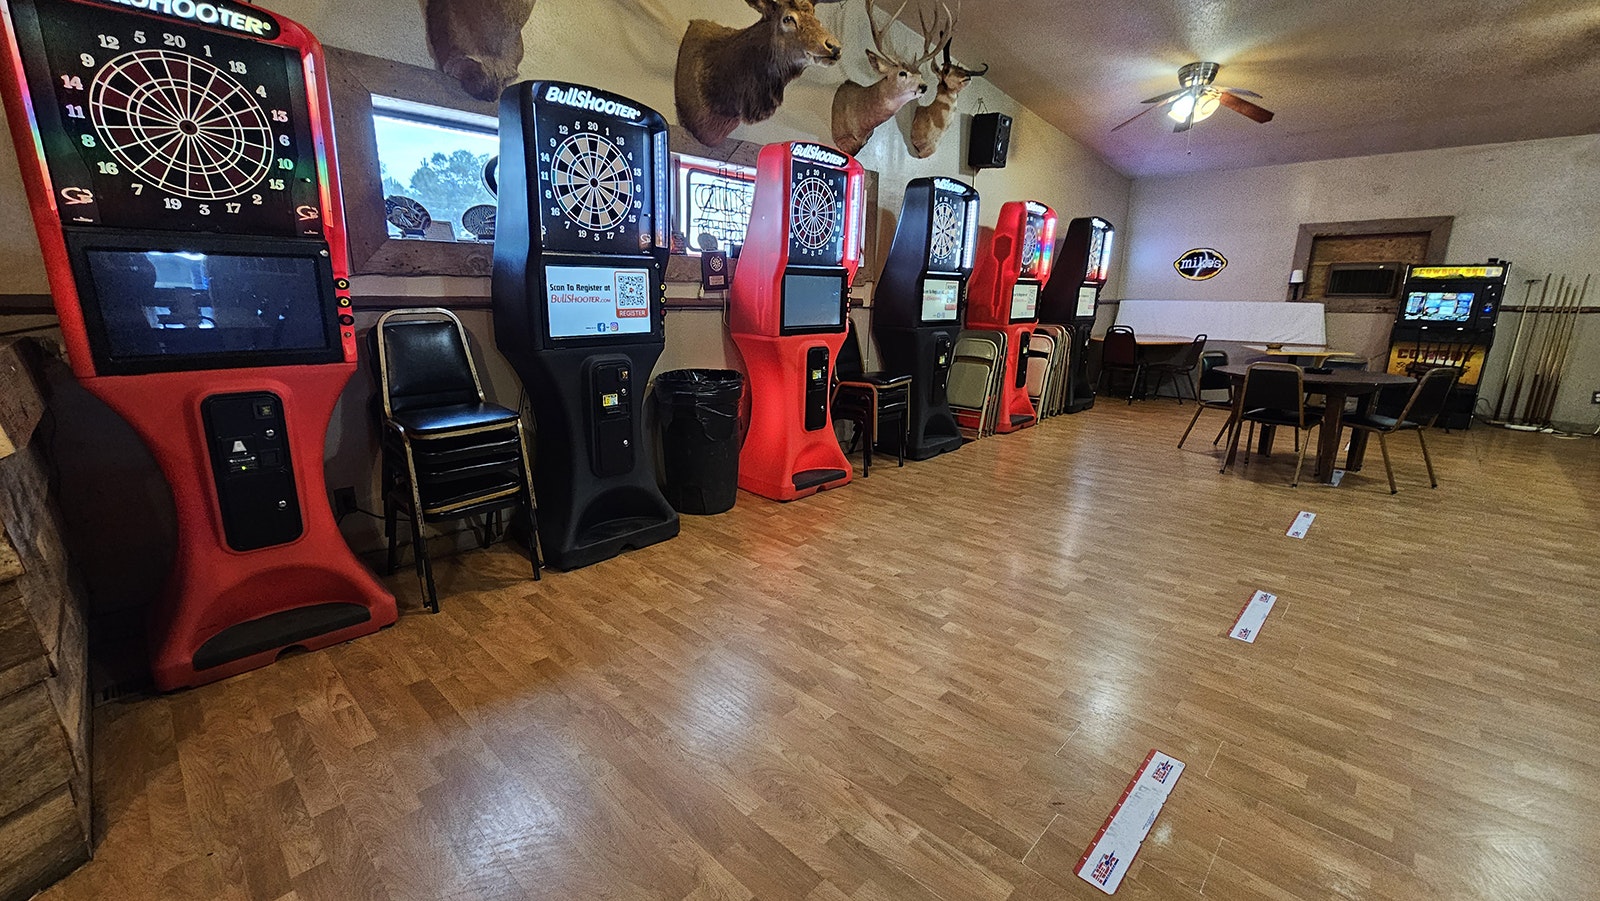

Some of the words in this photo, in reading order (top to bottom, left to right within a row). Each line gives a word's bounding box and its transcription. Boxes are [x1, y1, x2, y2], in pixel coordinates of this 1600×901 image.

[98, 34, 120, 50] 12
[134, 31, 147, 44] 5
[163, 33, 187, 49] 20
[203, 45, 213, 58] 1
[80, 53, 95, 67] 9
[229, 61, 247, 75] 18
[61, 75, 84, 91] 14
[255, 85, 267, 98] 4
[66, 104, 86, 119] 11
[270, 110, 288, 122] 13
[558, 125, 568, 135] 12
[574, 121, 581, 130] 5
[587, 121, 598, 131] 20
[605, 127, 610, 136] 1
[81, 135, 96, 148] 8
[279, 134, 290, 146] 6
[550, 138, 557, 147] 9
[616, 136, 625, 146] 18
[540, 152, 549, 162] 14
[627, 152, 633, 161] 4
[97, 161, 119, 175] 16
[277, 157, 293, 171] 10
[541, 171, 549, 180] 11
[633, 167, 642, 177] 13
[131, 183, 144, 195] 7
[269, 178, 285, 190] 15
[635, 184, 641, 193] 6
[545, 189, 552, 199] 8
[164, 197, 182, 210] 19
[252, 194, 262, 205] 2
[633, 200, 642, 209] 10
[199, 204, 210, 215] 3
[226, 202, 241, 214] 17
[550, 206, 560, 216] 16
[628, 214, 636, 223] 15
[564, 221, 571, 229] 7
[619, 225, 625, 233] 2
[578, 229, 587, 238] 19
[594, 233, 600, 241] 3
[606, 231, 615, 240] 17
[1180, 256, 1222, 270] mike's
[1419, 267, 1460, 276] COWBOY
[549, 283, 565, 292] Scan
[566, 283, 575, 291] To
[576, 283, 602, 293] Register
[619, 309, 646, 317] REGISTER
